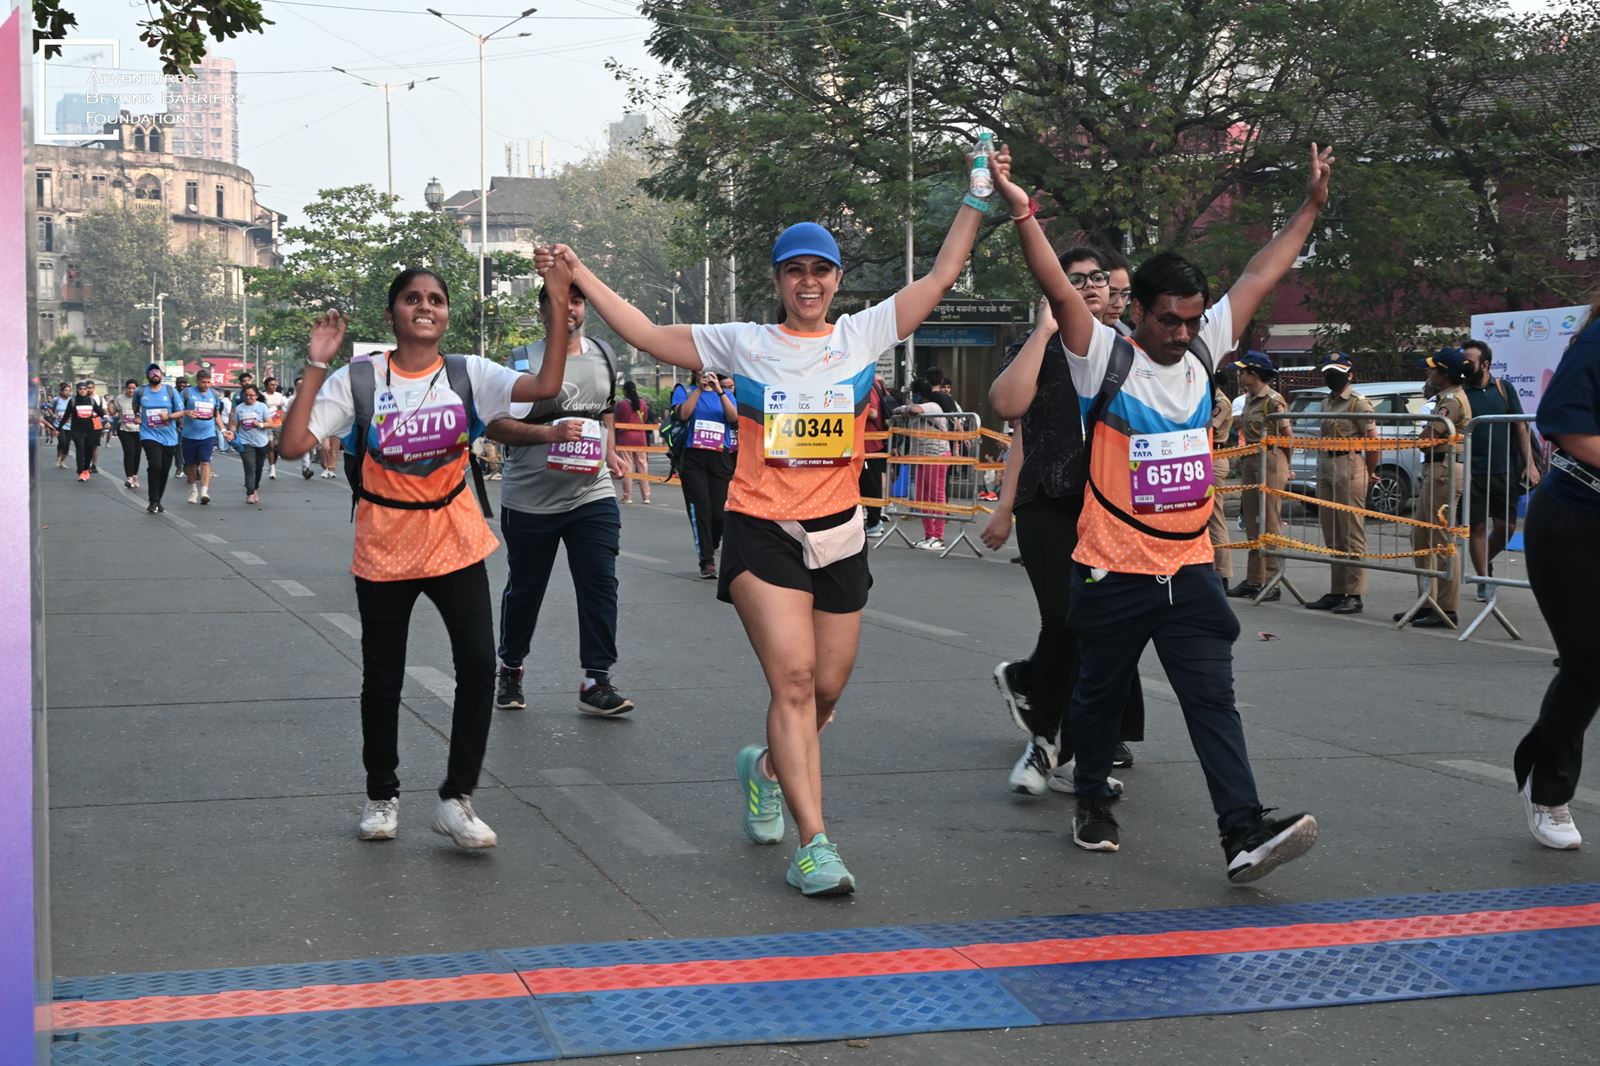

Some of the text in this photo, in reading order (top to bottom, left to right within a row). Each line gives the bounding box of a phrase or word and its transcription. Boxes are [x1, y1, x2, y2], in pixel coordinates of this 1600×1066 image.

[1491, 361, 1507, 372] ning
[1505, 374, 1536, 383] Barriers:
[1519, 388, 1536, 398] One,
[392, 410, 456, 437] 65770
[781, 418, 844, 438] 40344
[558, 441, 594, 455] 86821
[1146, 460, 1205, 486] 65798
